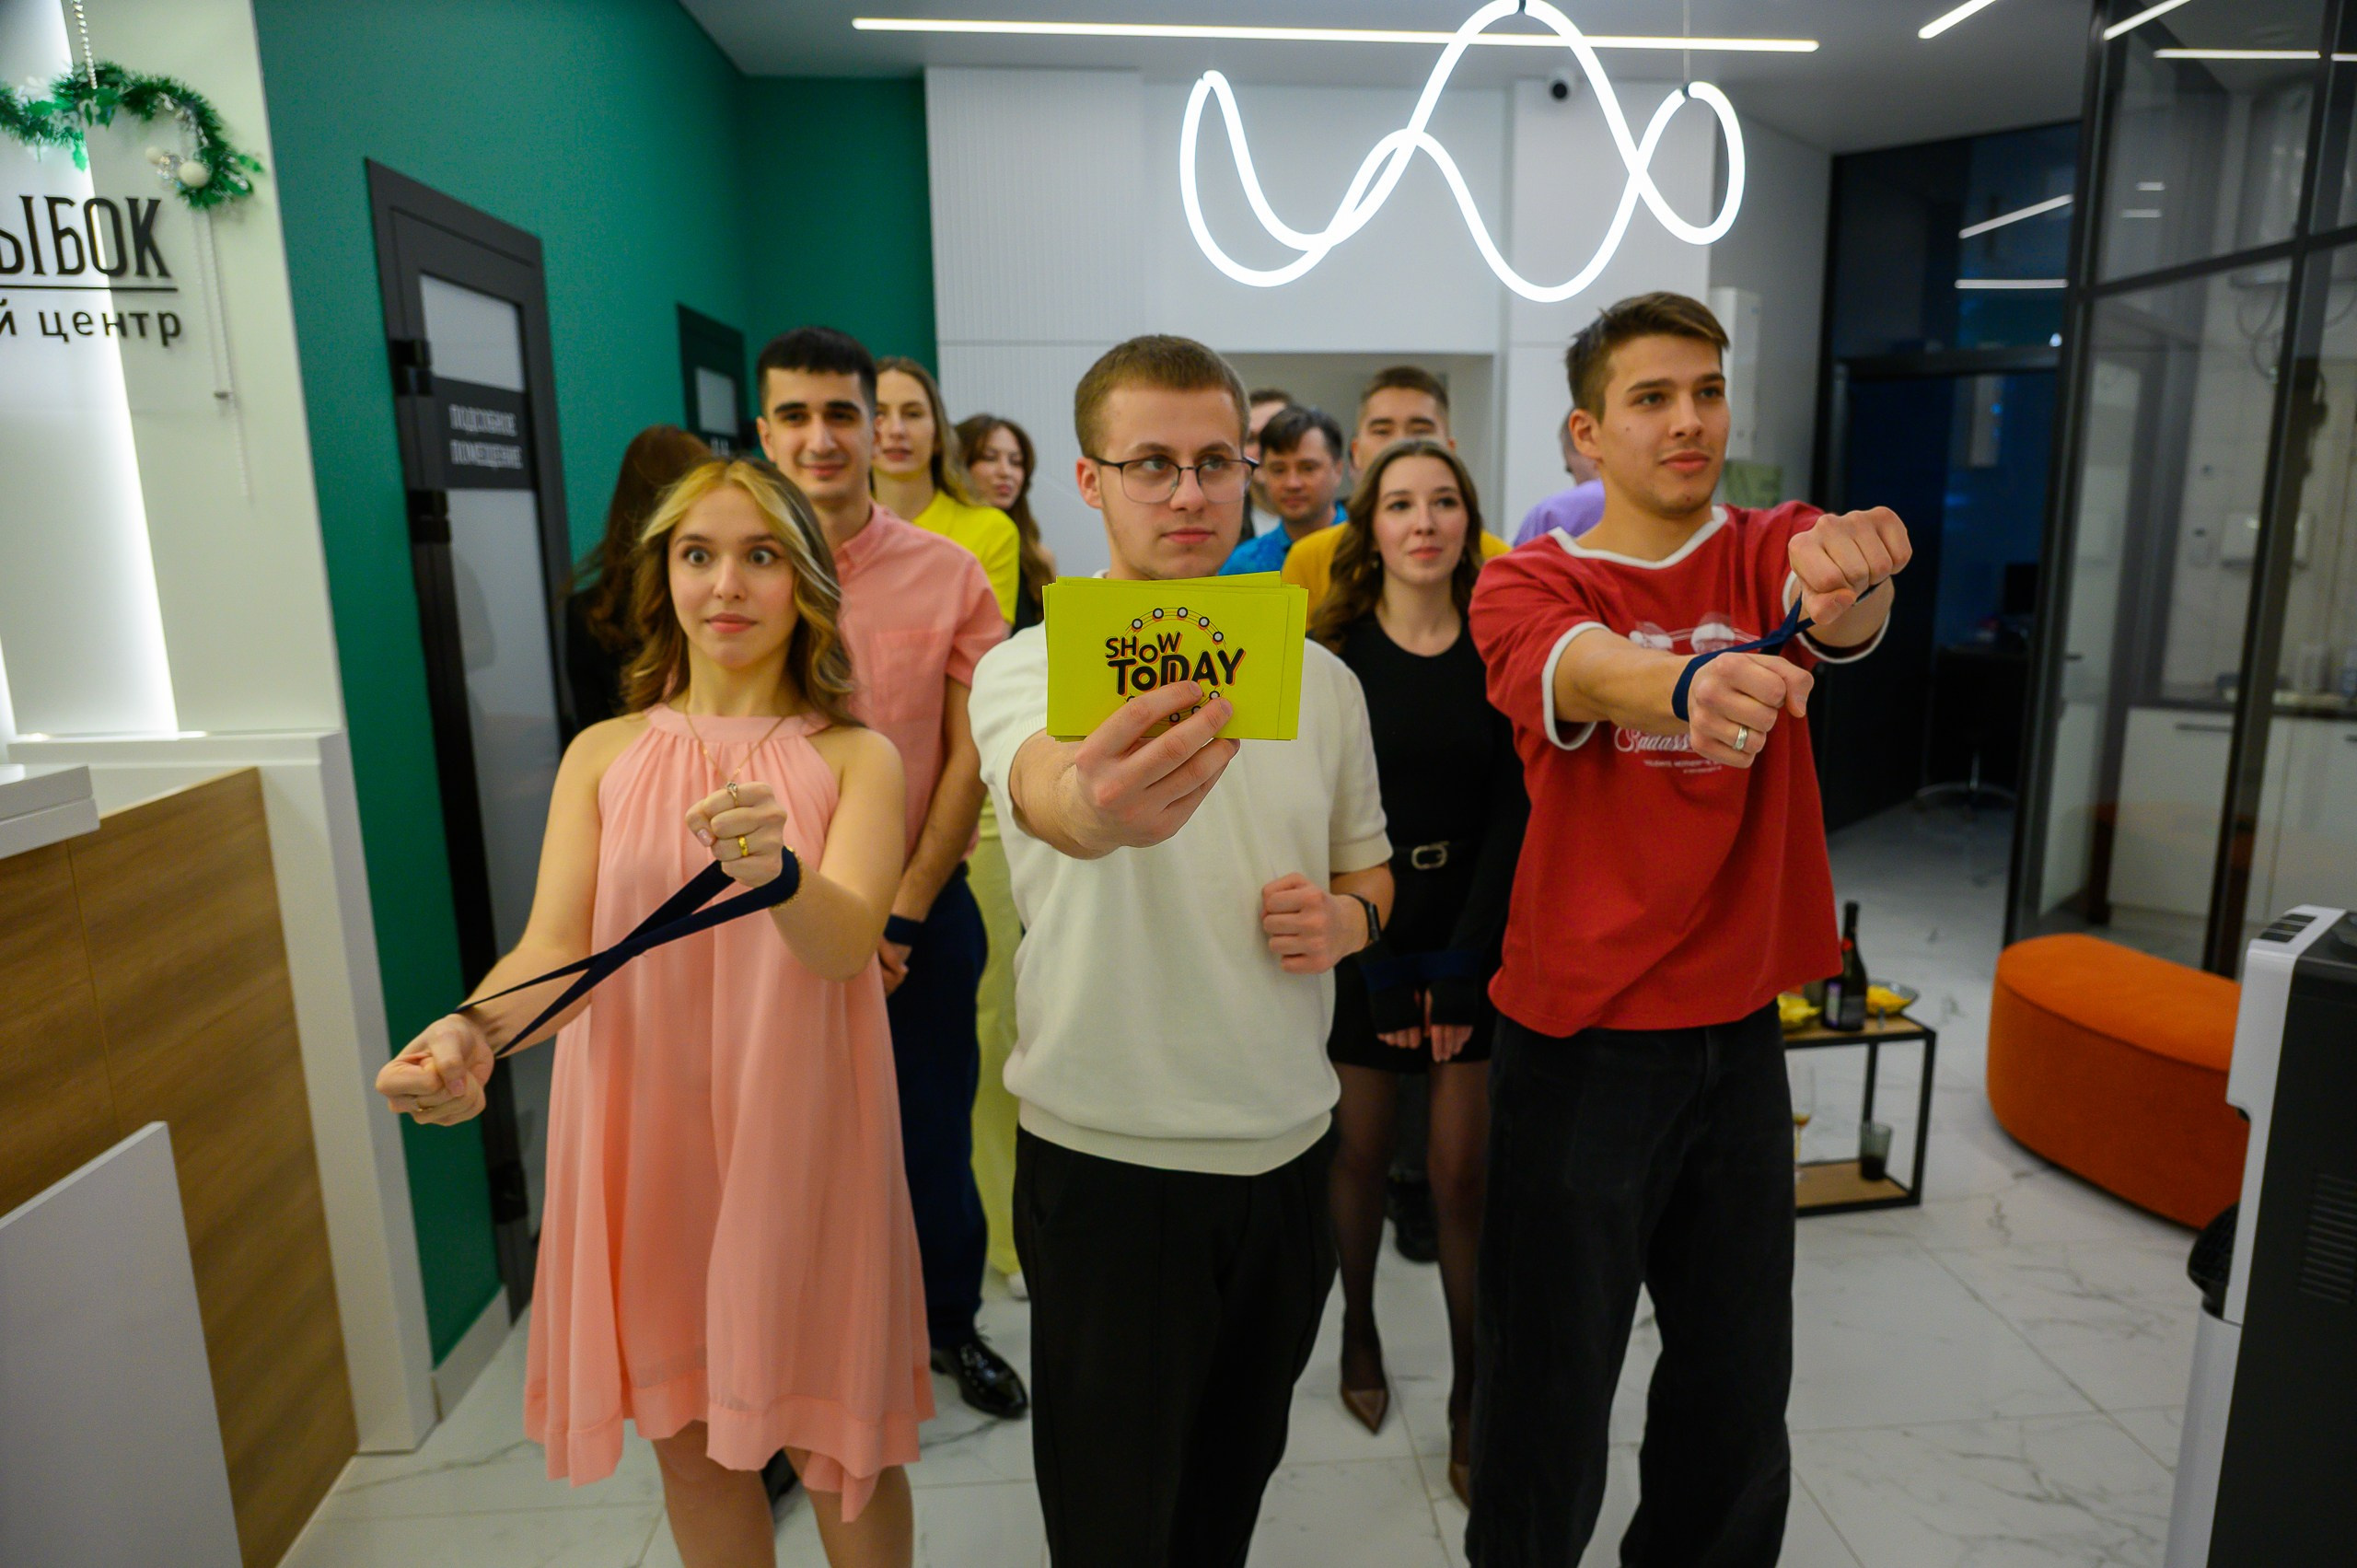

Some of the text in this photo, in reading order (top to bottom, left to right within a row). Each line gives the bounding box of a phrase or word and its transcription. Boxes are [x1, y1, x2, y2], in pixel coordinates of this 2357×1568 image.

[0, 194, 172, 278] ЫБОК
[38, 309, 181, 347] центр
[1105, 631, 1183, 664] SHOW
